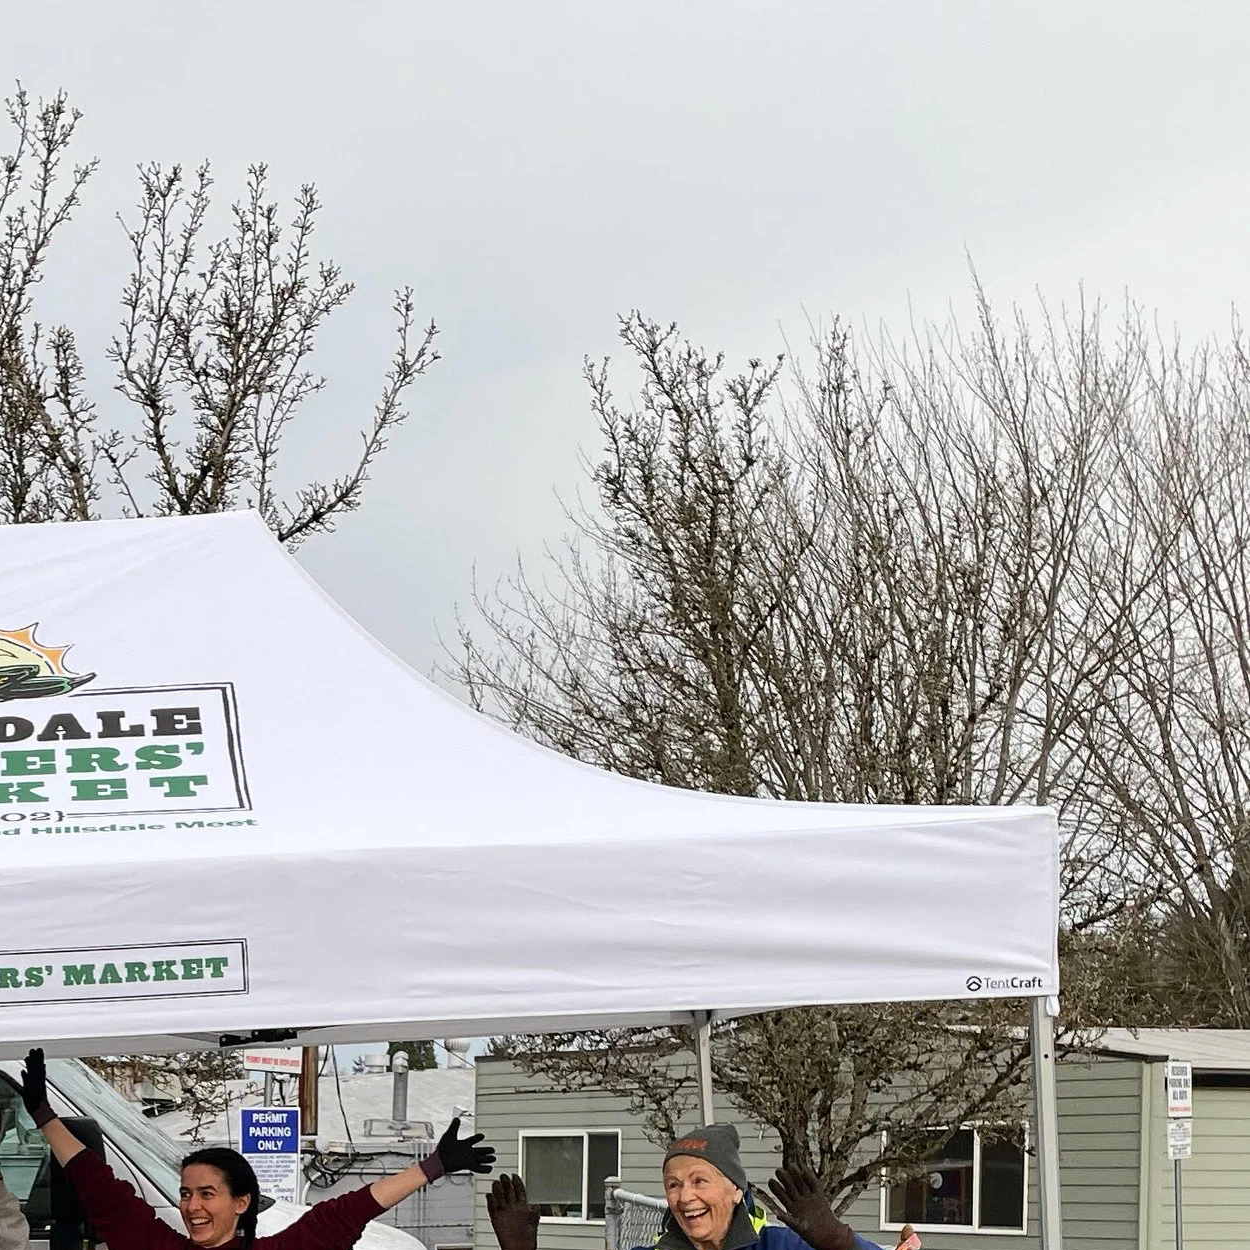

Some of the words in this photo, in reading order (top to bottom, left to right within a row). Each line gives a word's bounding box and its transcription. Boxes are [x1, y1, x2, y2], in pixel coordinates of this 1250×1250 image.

[31, 823, 166, 834] Hillsdale
[175, 818, 258, 828] Meet
[63, 956, 228, 985] MARKET
[984, 976, 1043, 989] TentCraft
[252, 1113, 288, 1123] PERMIT
[249, 1126, 292, 1137] PARKING
[257, 1140, 283, 1150] ONLY
